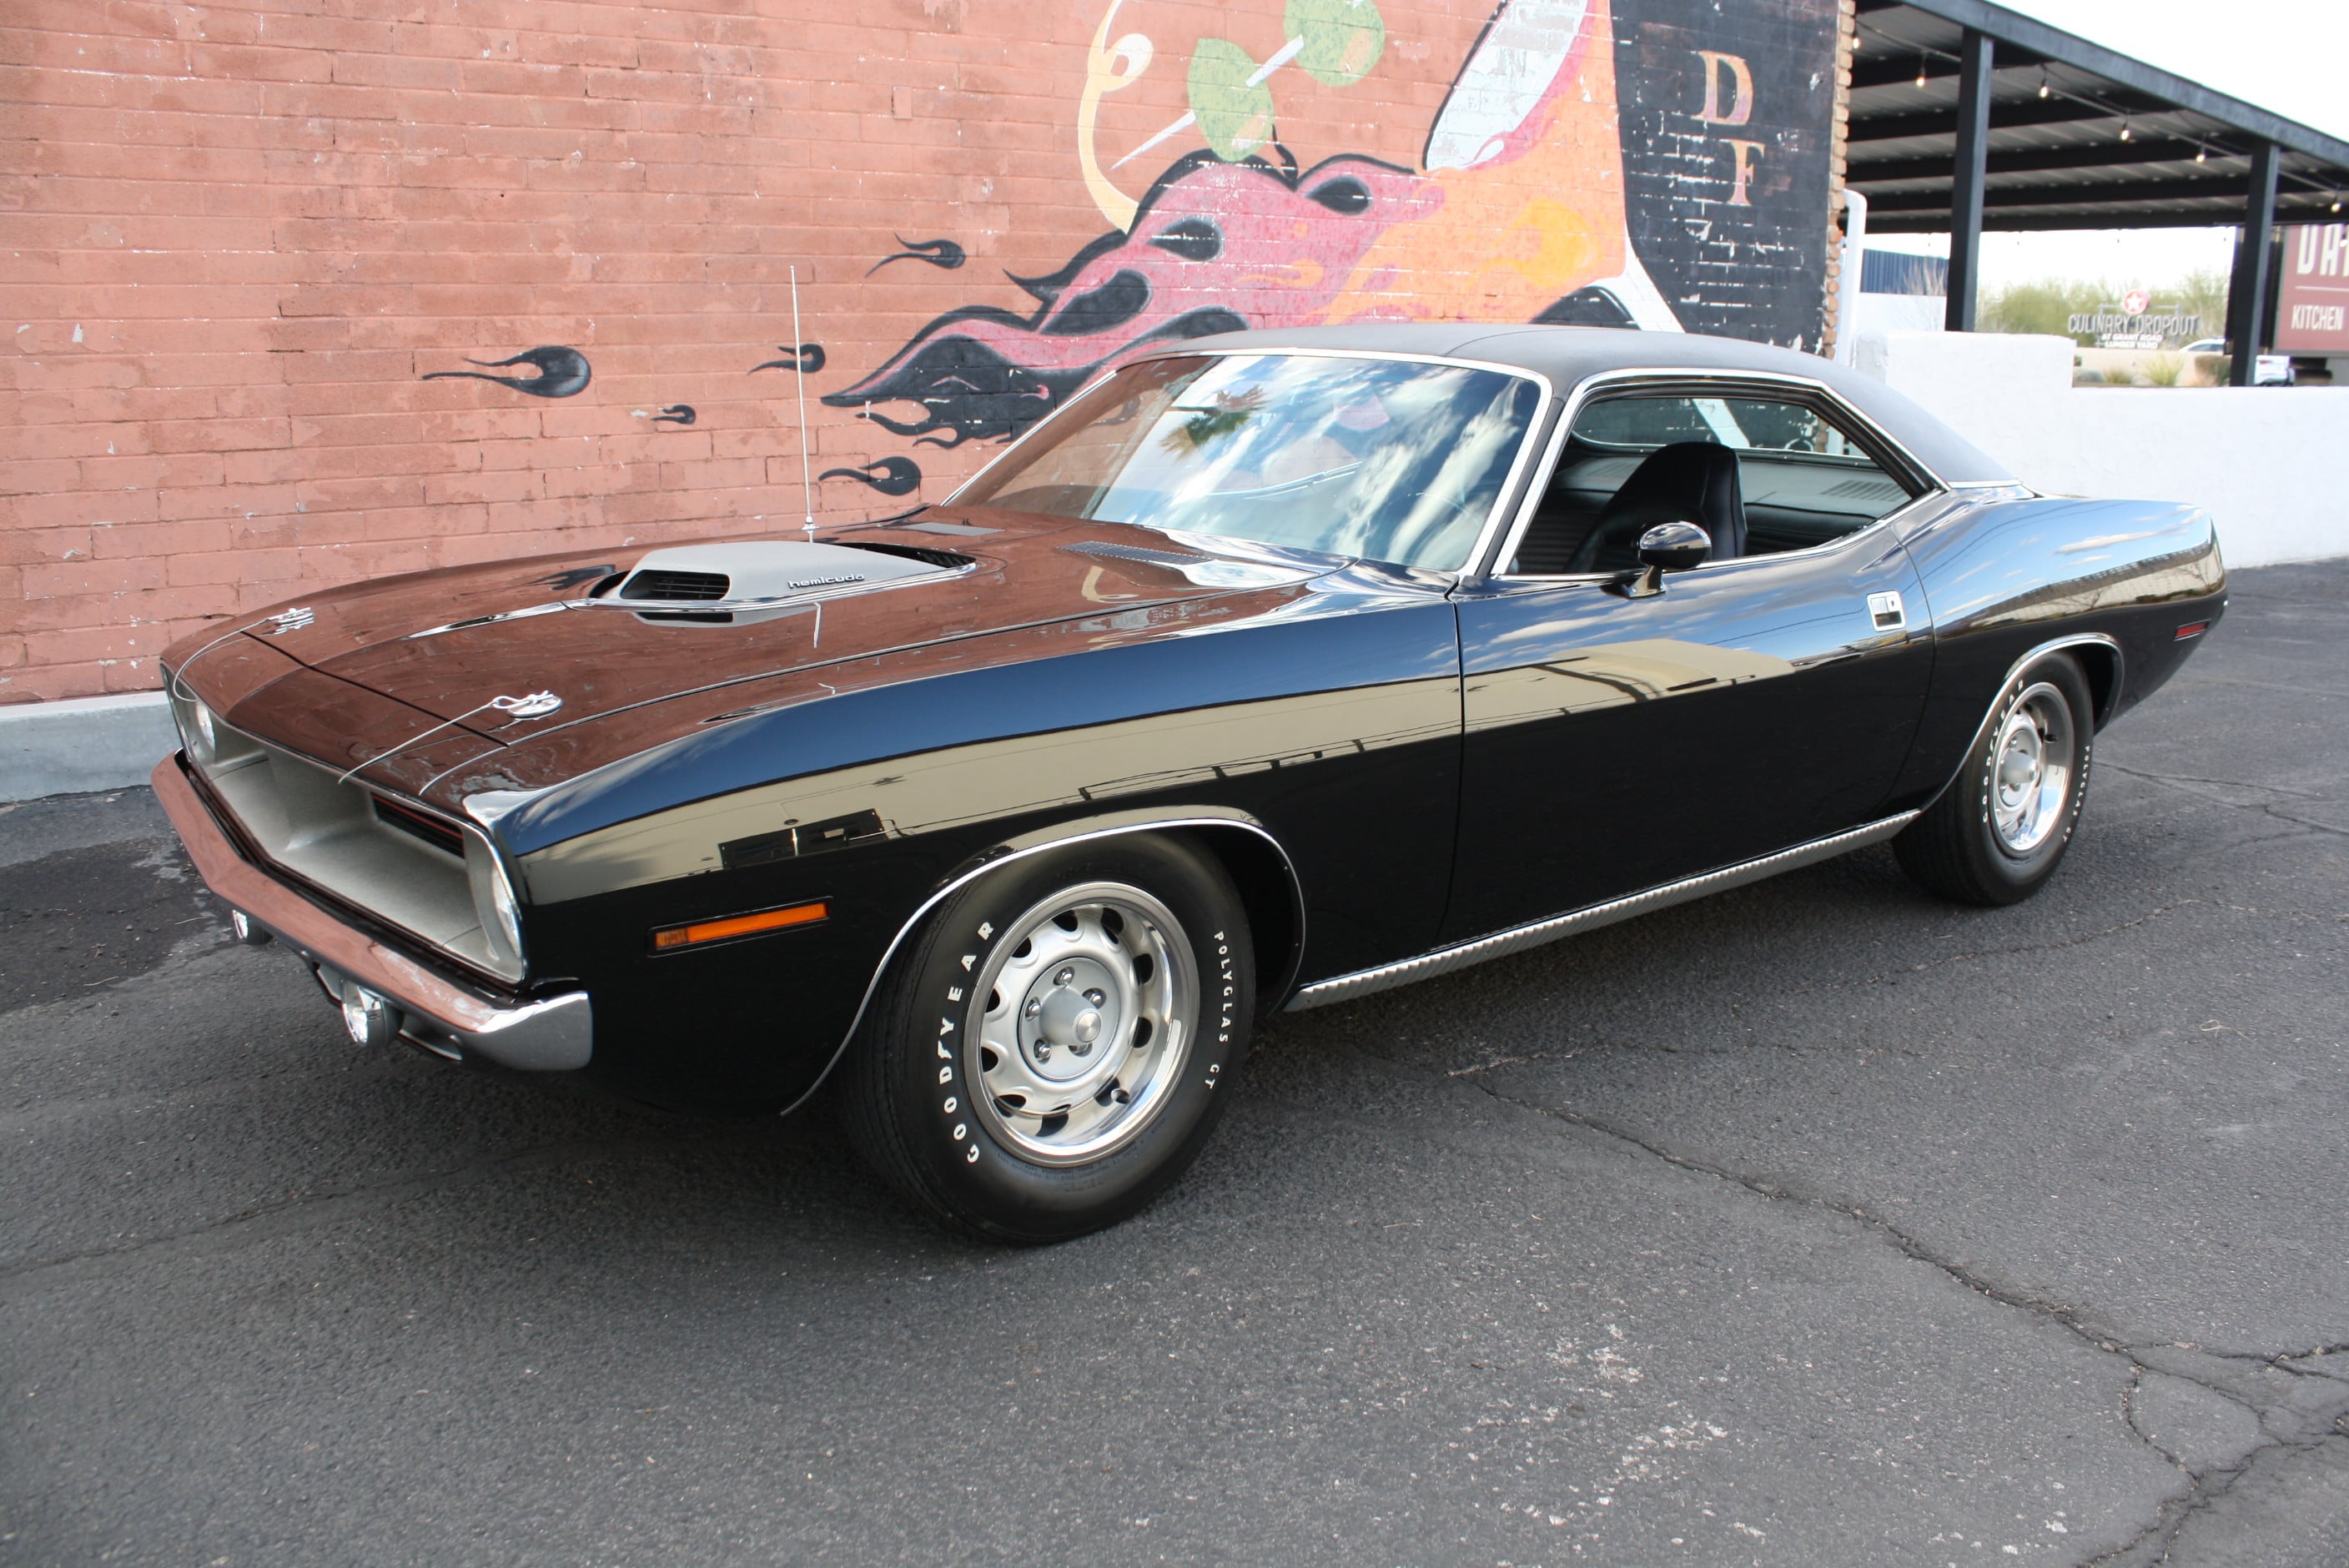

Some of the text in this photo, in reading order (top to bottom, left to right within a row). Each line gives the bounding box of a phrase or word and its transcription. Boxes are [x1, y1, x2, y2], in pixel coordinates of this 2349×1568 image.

[1691, 50, 1753, 126] D
[1724, 138, 1765, 206] F
[2296, 224, 2349, 277] DA
[2068, 314, 2201, 335] CULINARY DROPOUT
[2291, 304, 2345, 330] KITCHEN
[787, 573, 865, 589] hemicuda
[1205, 930, 1234, 1089] POLYGLAS GT
[937, 921, 994, 1163] GOODYEAR
